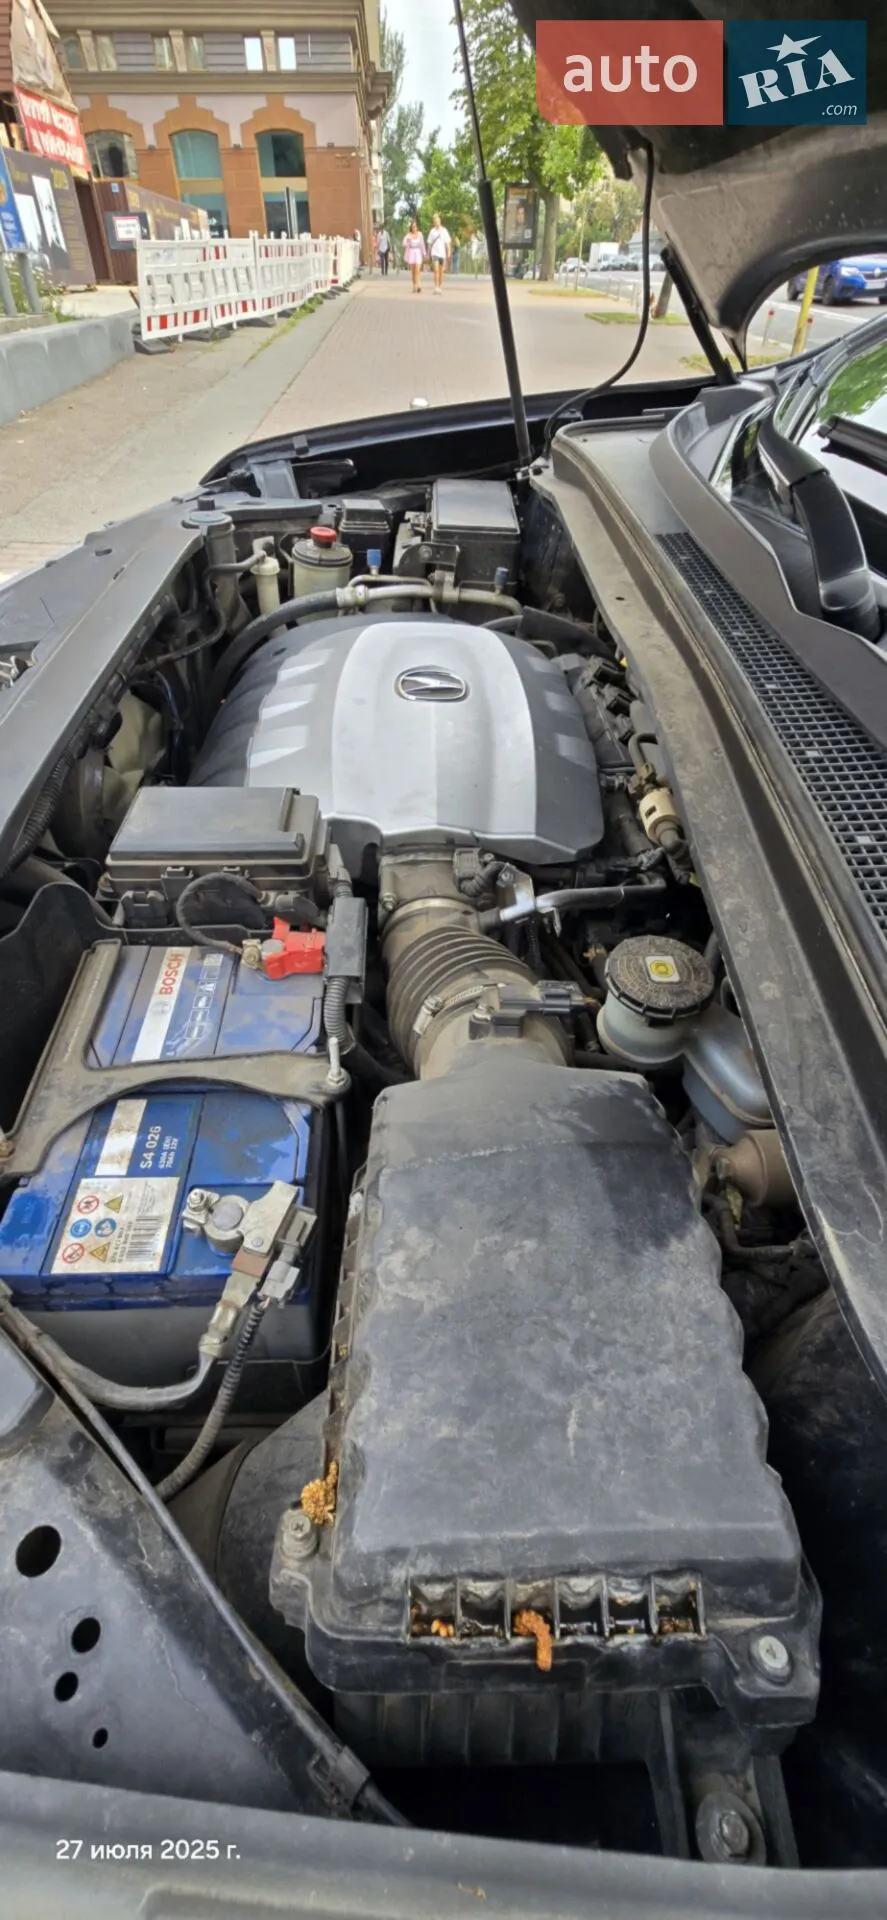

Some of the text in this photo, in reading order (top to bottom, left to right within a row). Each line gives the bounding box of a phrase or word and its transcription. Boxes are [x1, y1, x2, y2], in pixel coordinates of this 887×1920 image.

[159, 953, 184, 995] BOSCH
[145, 1126, 161, 1149] 026
[140, 1152, 154, 1169] S4
